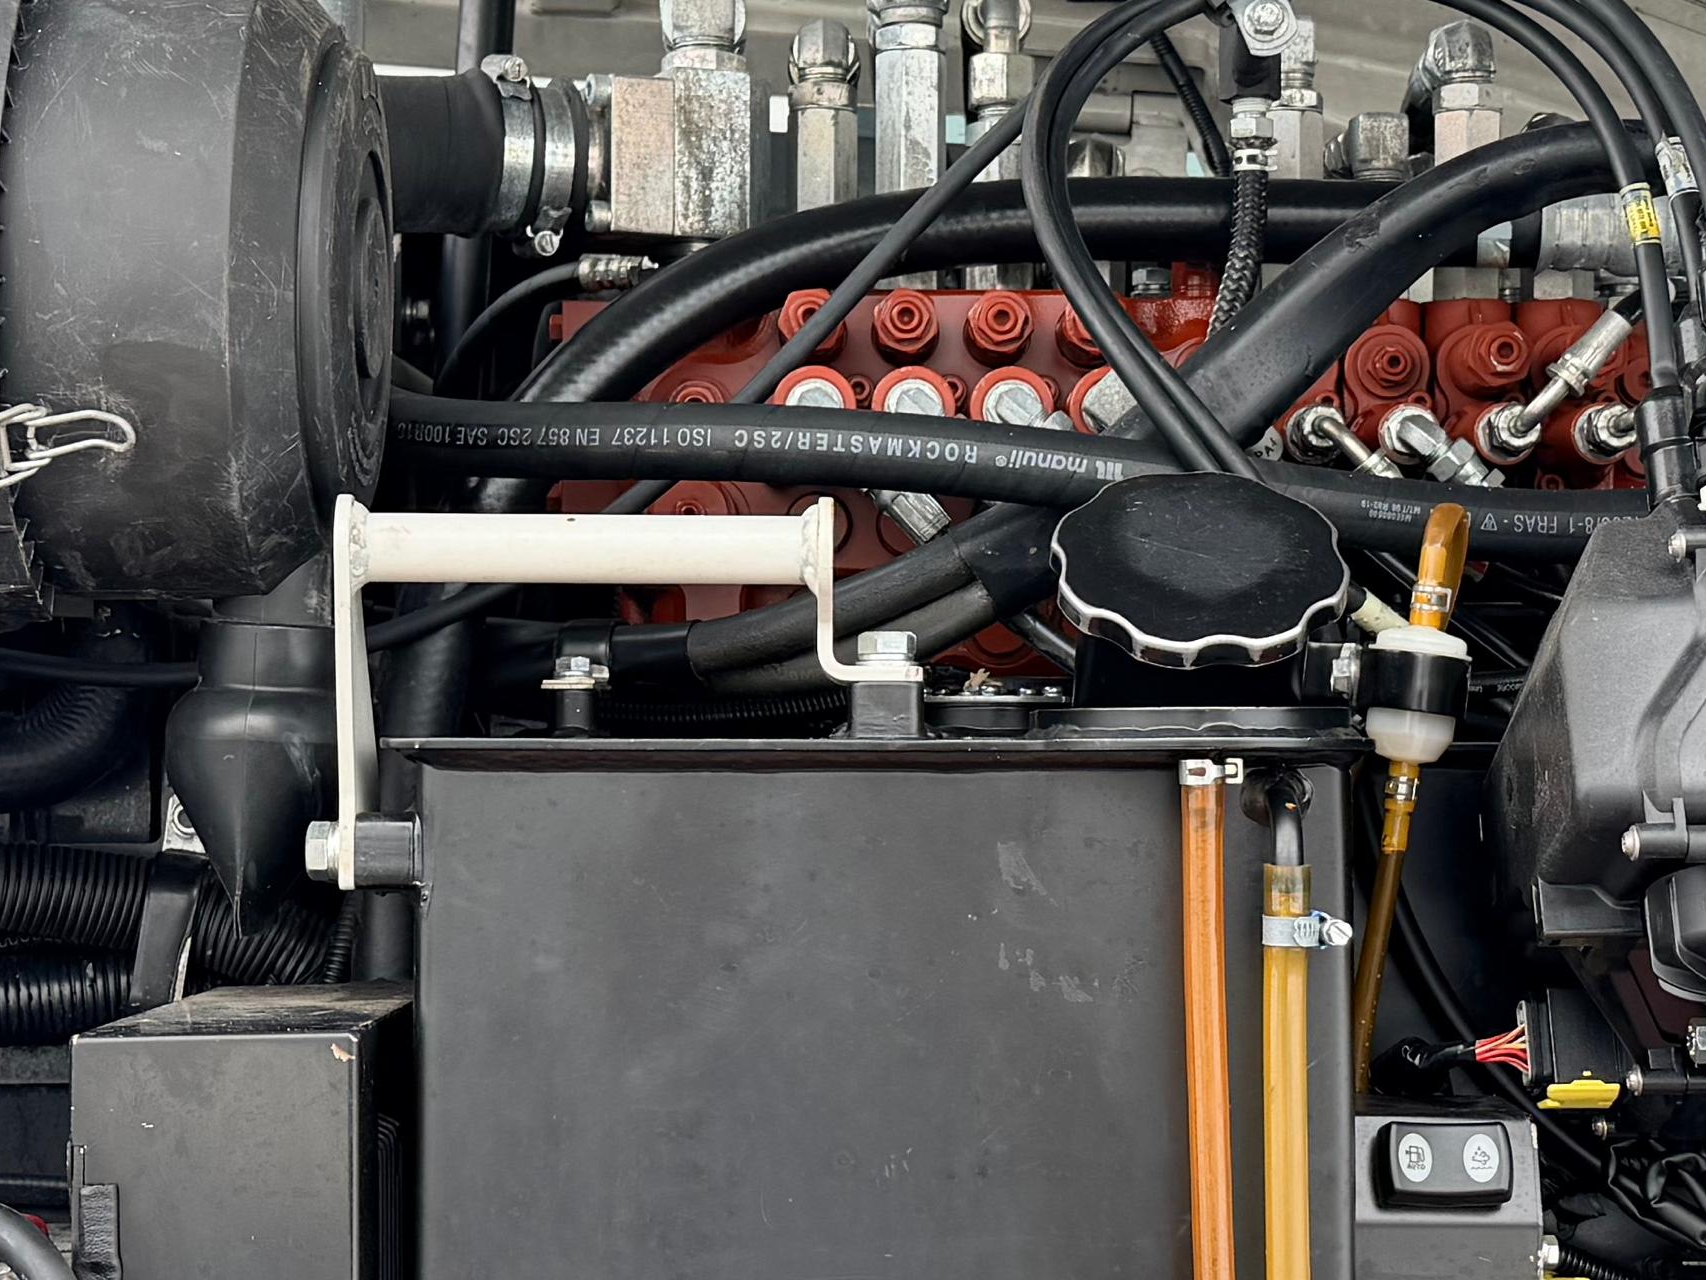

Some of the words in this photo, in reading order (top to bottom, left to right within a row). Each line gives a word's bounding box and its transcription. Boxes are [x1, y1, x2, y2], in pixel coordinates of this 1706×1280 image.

[455, 425, 489, 446] SAE
[496, 426, 533, 446] 2SC
[537, 426, 571, 446] 857
[575, 427, 601, 447] EN
[611, 427, 670, 447] 11237
[677, 427, 712, 448] ISO
[734, 428, 978, 465] ROCKMASTER/2SC
[1513, 513, 1558, 535] FRAS
